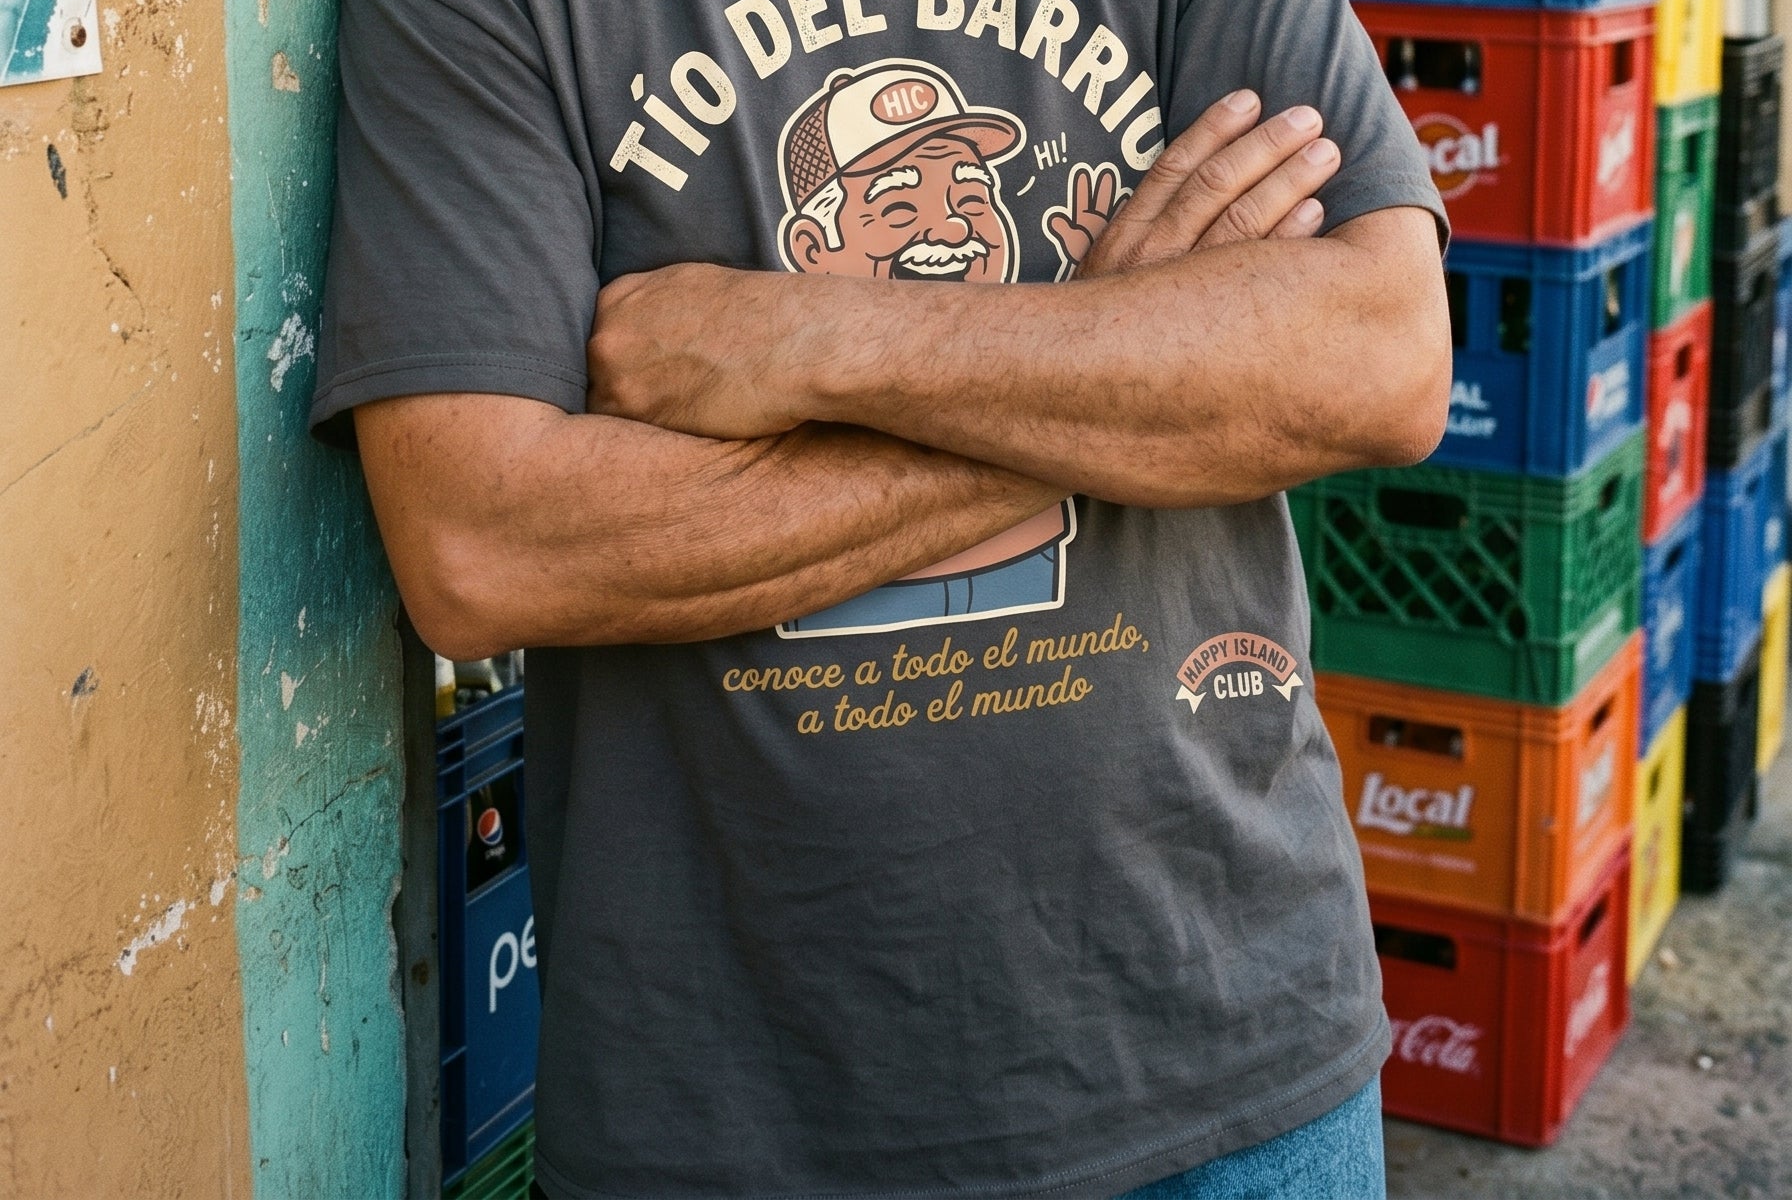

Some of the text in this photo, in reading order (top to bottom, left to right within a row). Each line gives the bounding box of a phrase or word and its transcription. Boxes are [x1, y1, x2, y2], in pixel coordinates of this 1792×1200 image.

[609, 50, 737, 192] TÍO
[881, 85, 928, 118] HIC
[1033, 131, 1068, 170] HI!
[722, 612, 1149, 692] conoce a todo el mundo,
[1183, 638, 1289, 685] HAPPY ISLAND
[797, 664, 1093, 734] a todo el mundo
[1213, 670, 1264, 699] CLUB
[1357, 771, 1475, 835] Local
